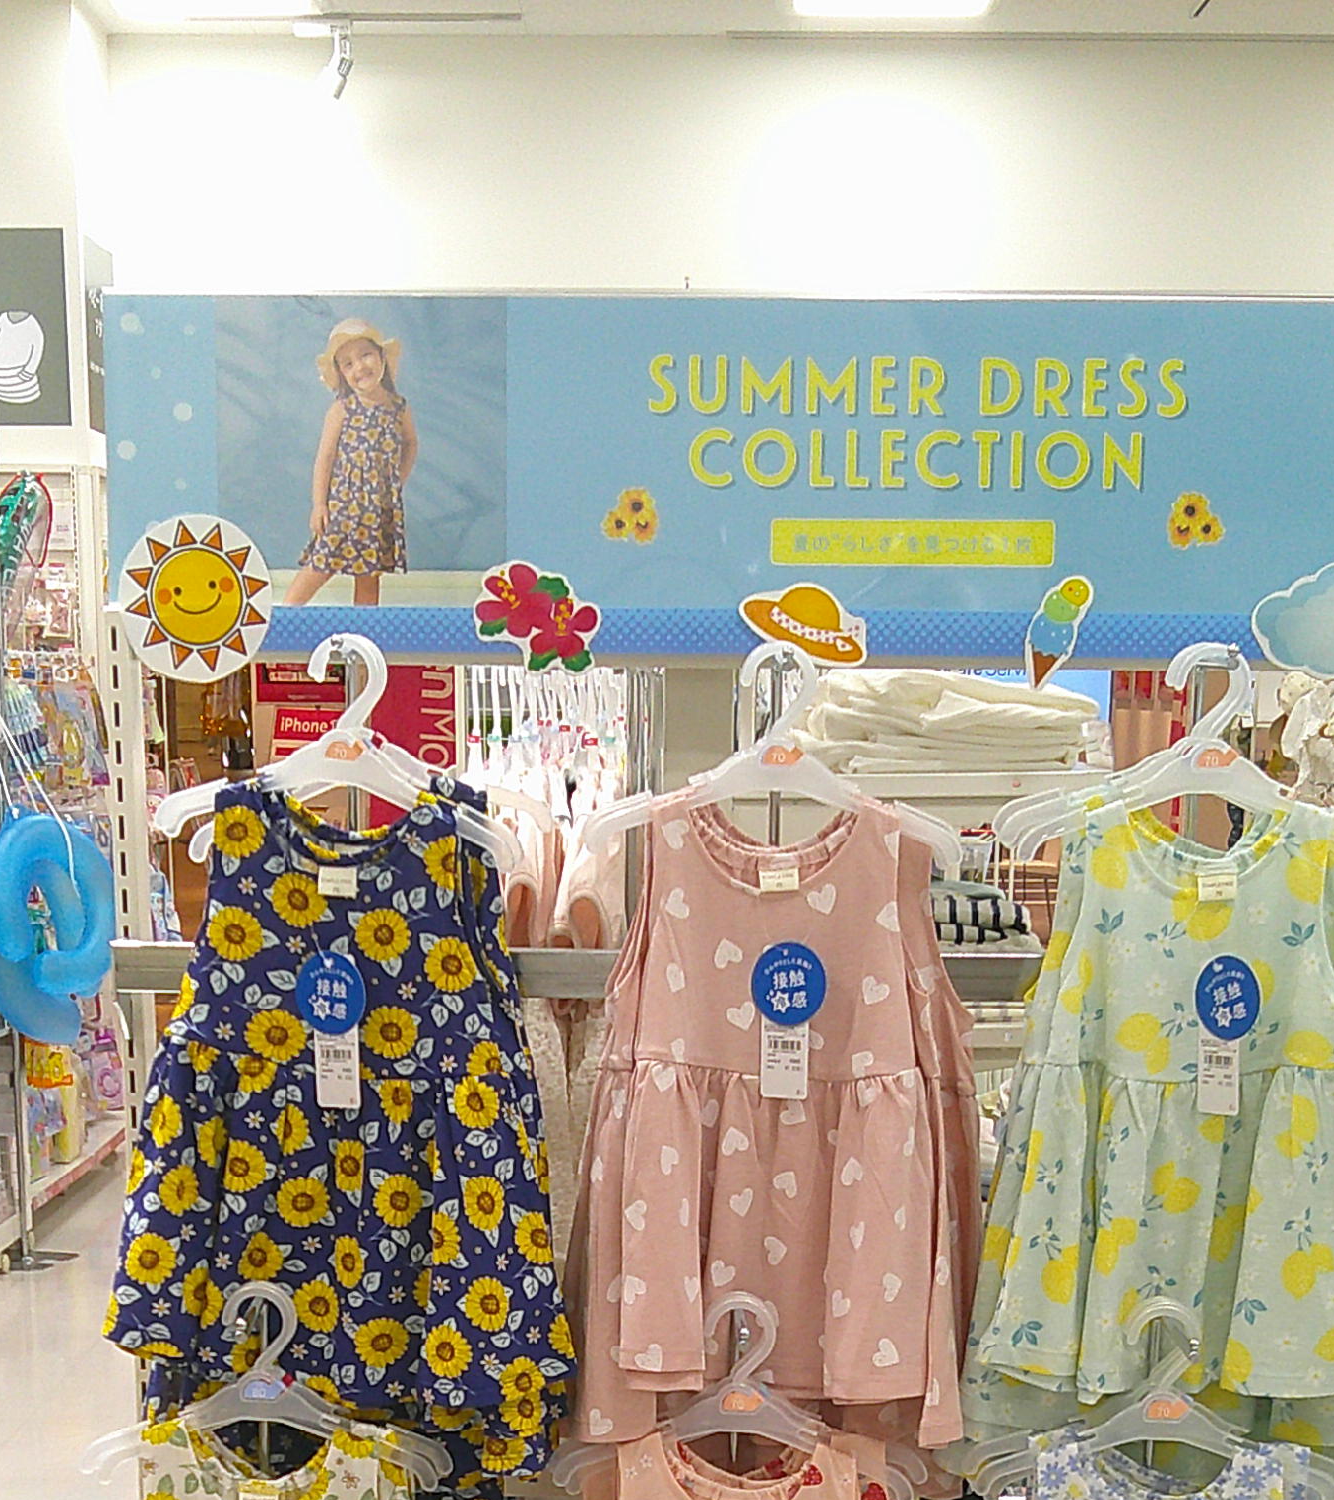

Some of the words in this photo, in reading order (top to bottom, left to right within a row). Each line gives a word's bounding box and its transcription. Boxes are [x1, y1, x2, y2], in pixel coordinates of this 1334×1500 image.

[648, 353, 945, 416] SUMMER
[979, 357, 1187, 418] DRESS
[688, 427, 1143, 491] COLLECTION
[280, 714, 328, 733] iPhone
[417, 707, 457, 776] Mo
[1205, 755, 1220, 766] 70
[316, 979, 347, 999] 接触
[772, 969, 806, 989] 接触
[1213, 982, 1243, 1006] 接触
